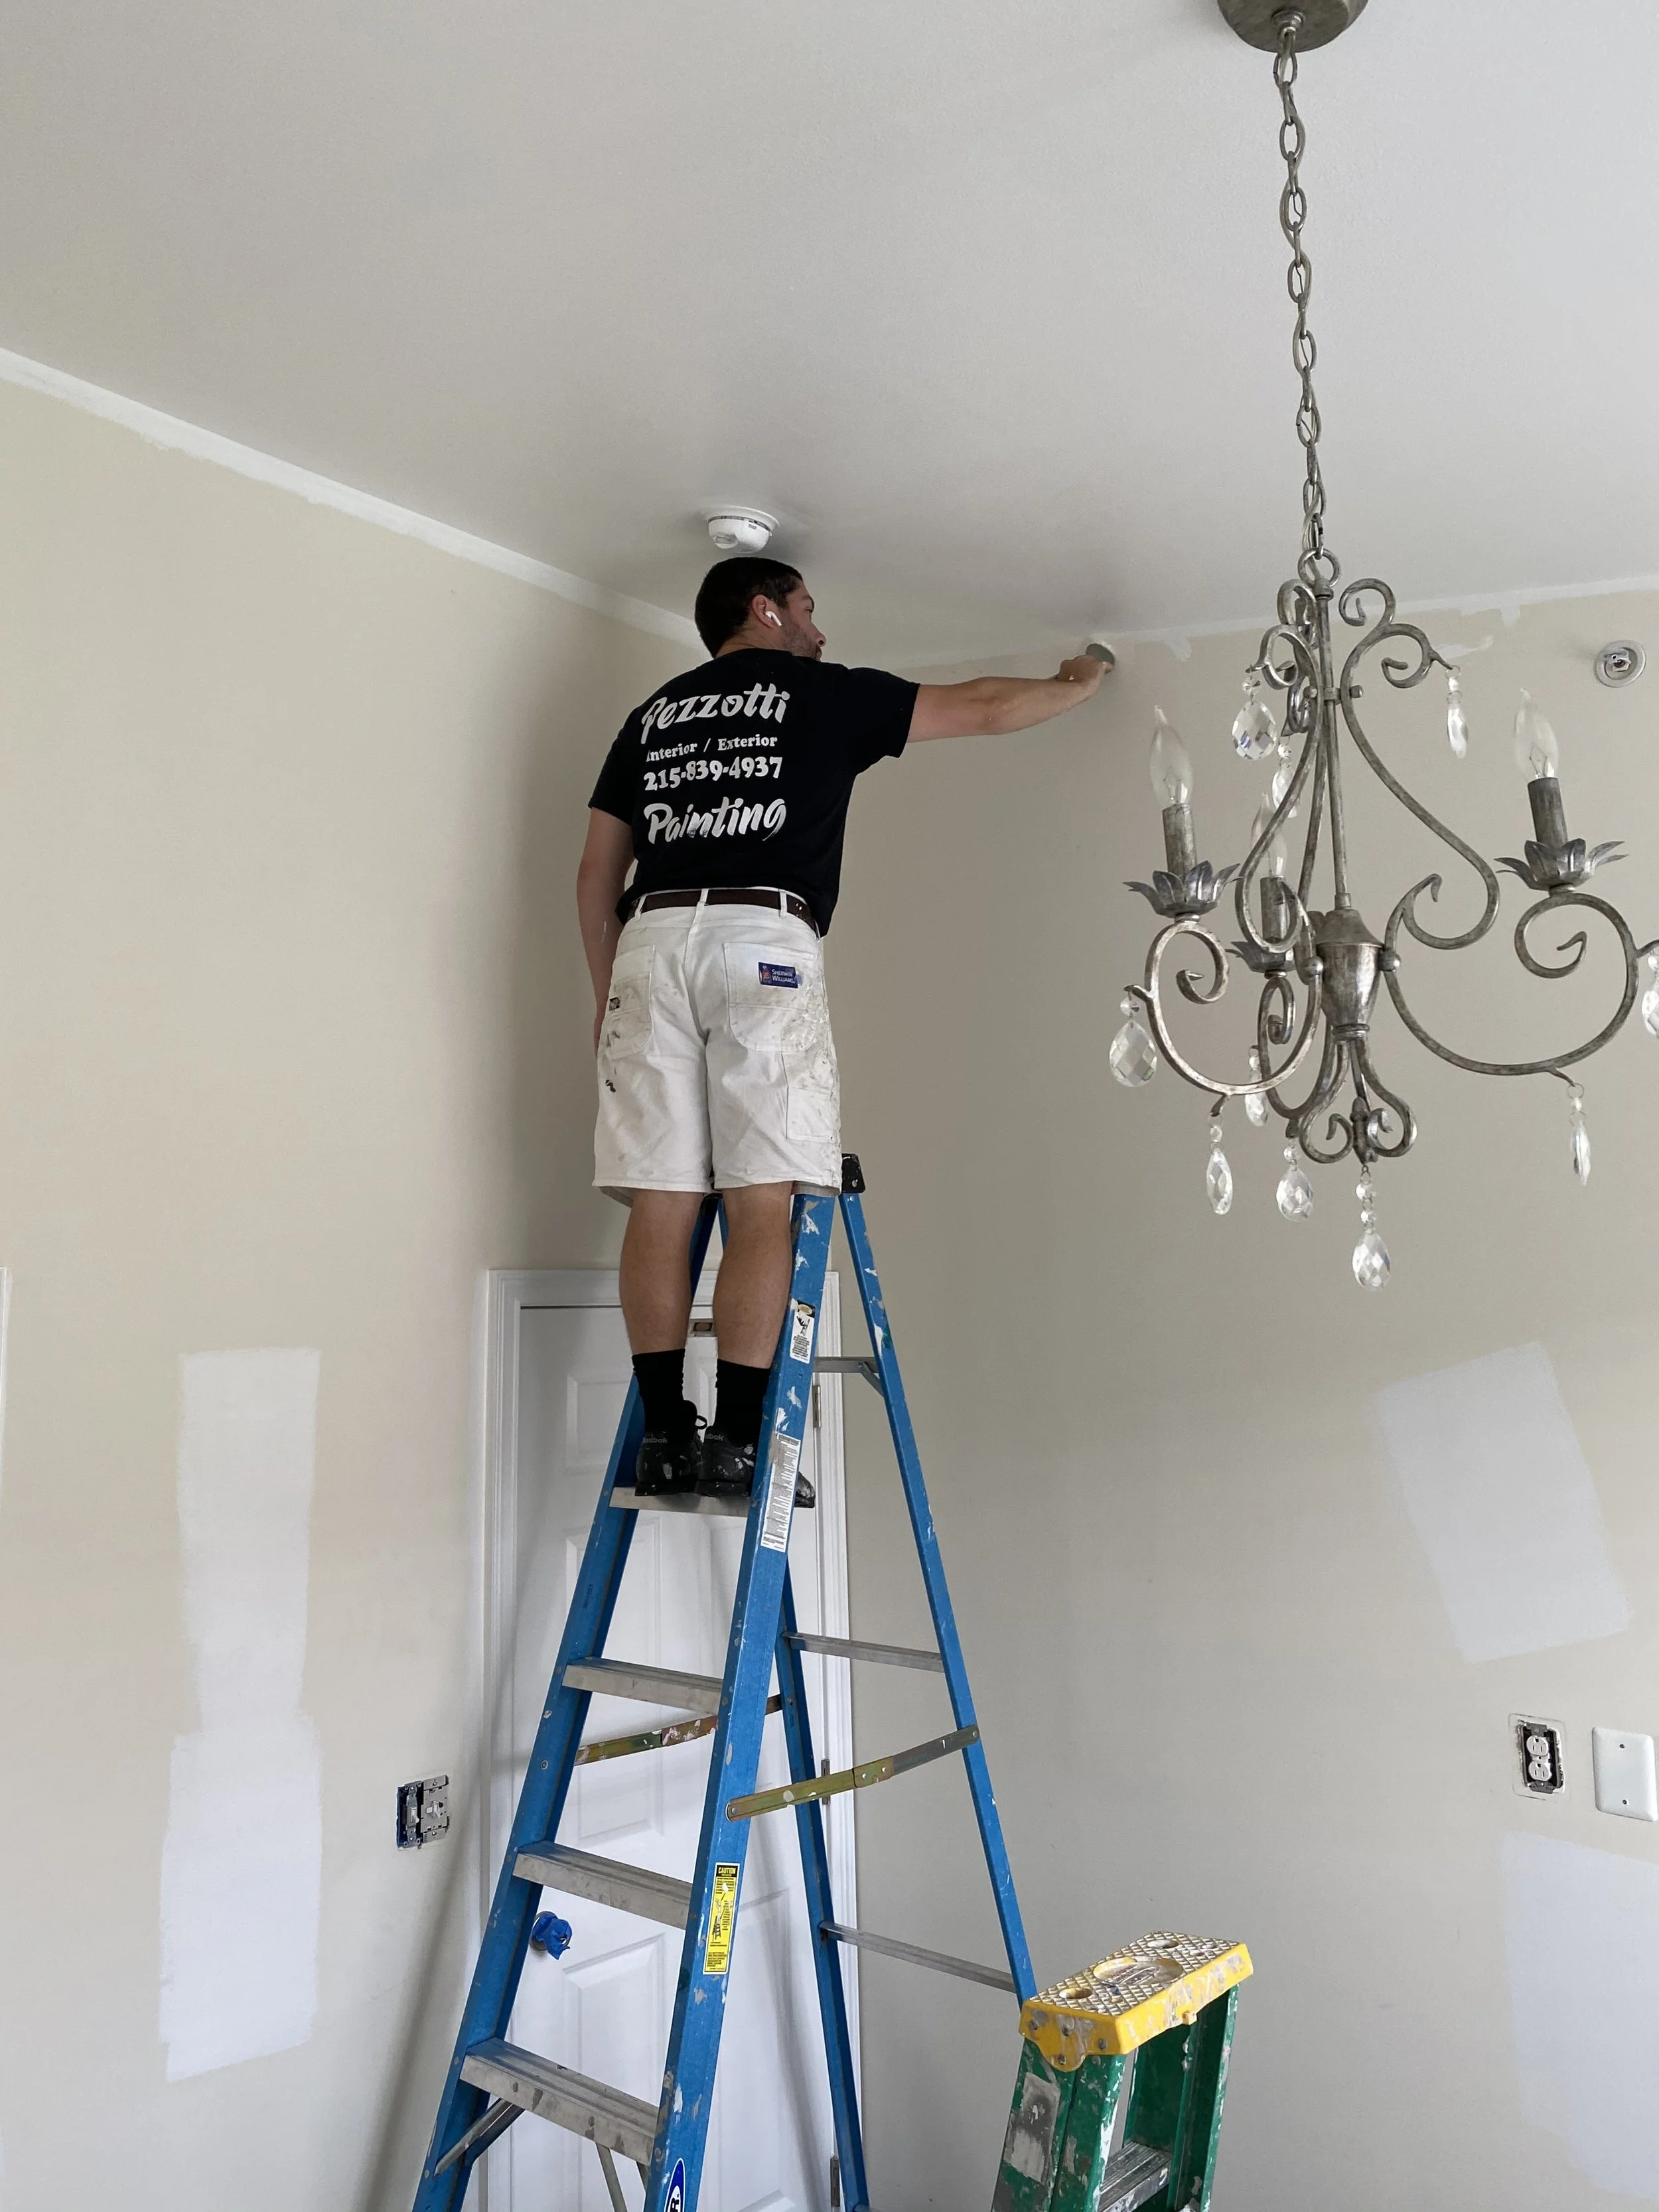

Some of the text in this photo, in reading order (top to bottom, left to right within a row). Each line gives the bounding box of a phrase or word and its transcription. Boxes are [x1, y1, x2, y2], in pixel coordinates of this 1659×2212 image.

[641, 683, 790, 744] Pezzotti
[646, 743, 697, 763] Interior
[717, 734, 778, 751] Exterior
[644, 757, 783, 791] 215-839-4937
[644, 796, 787, 845] Painting
